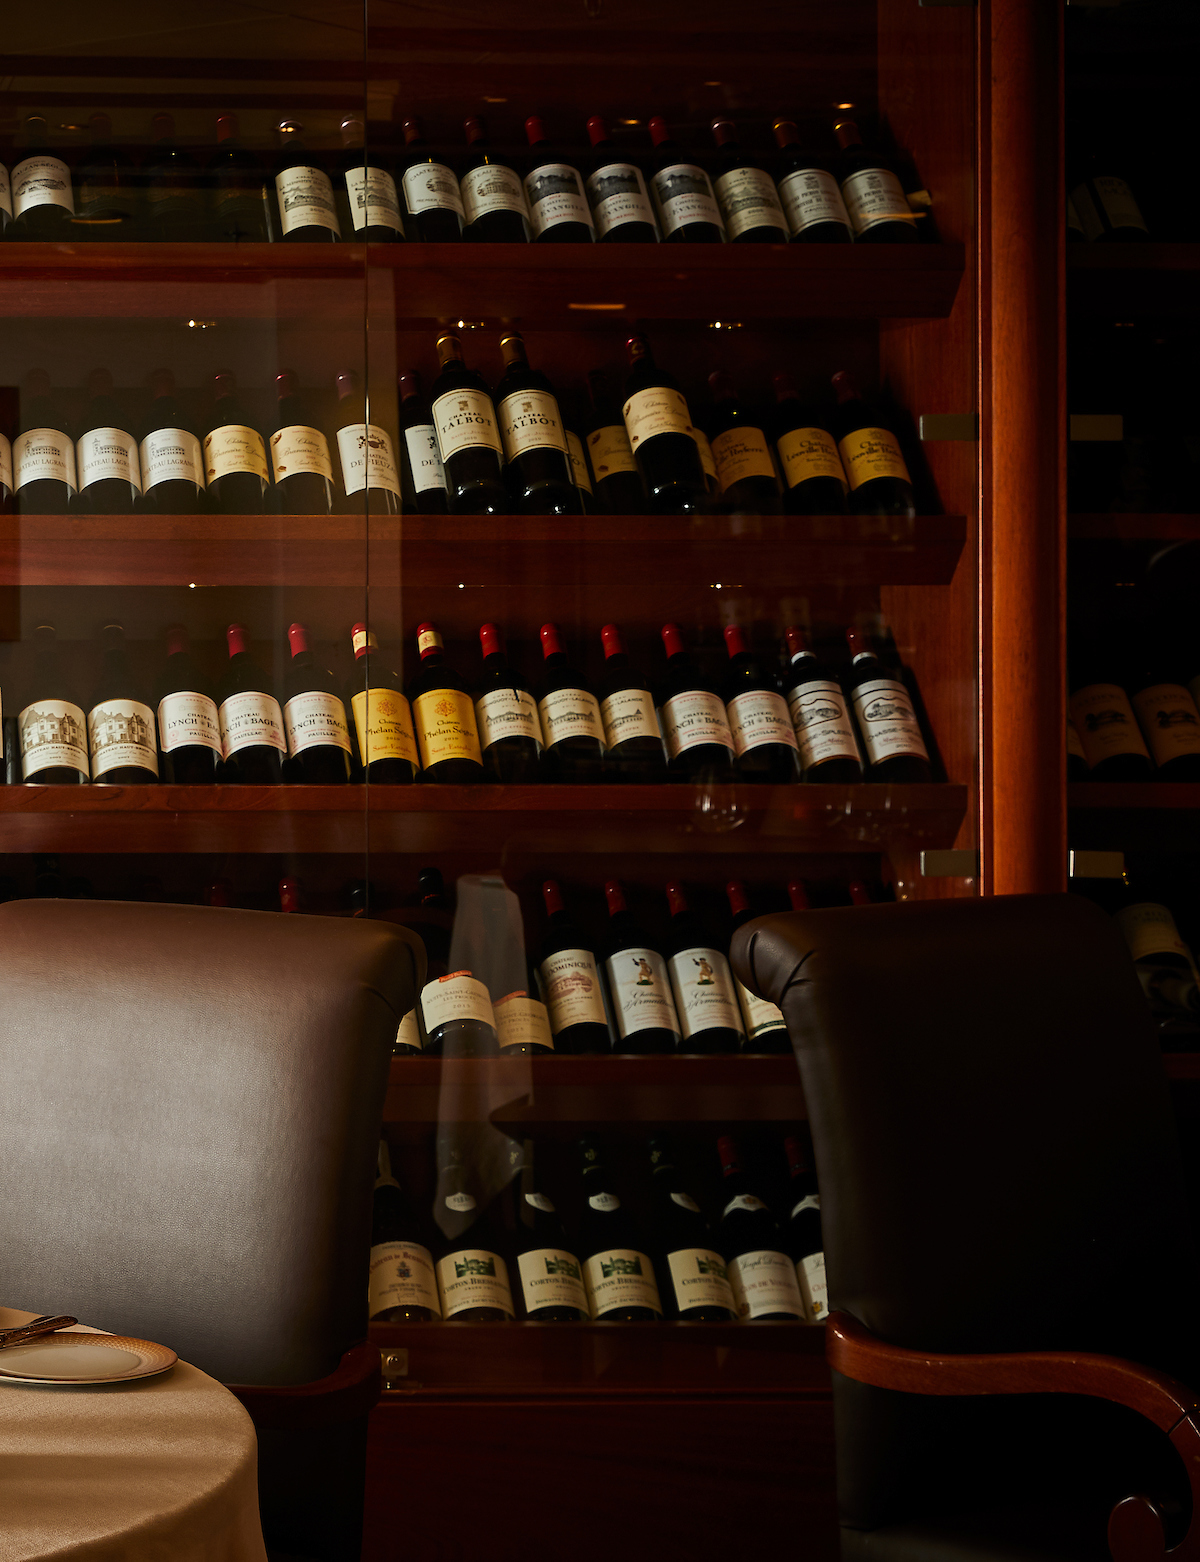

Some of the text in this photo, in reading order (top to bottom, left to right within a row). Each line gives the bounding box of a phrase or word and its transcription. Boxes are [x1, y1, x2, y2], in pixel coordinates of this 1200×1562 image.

[448, 412, 482, 421] CHATEAU
[512, 413, 546, 423] CHATEAU
[442, 417, 492, 434] TALBOT
[506, 417, 557, 436] TALBOT
[350, 460, 363, 468] DE
[232, 713, 259, 722] CHATEAU
[168, 718, 197, 729] LYNCH
[251, 718, 280, 730] BAGES
[290, 719, 316, 736] LYNCH
[234, 731, 262, 741] PAUILLAC
